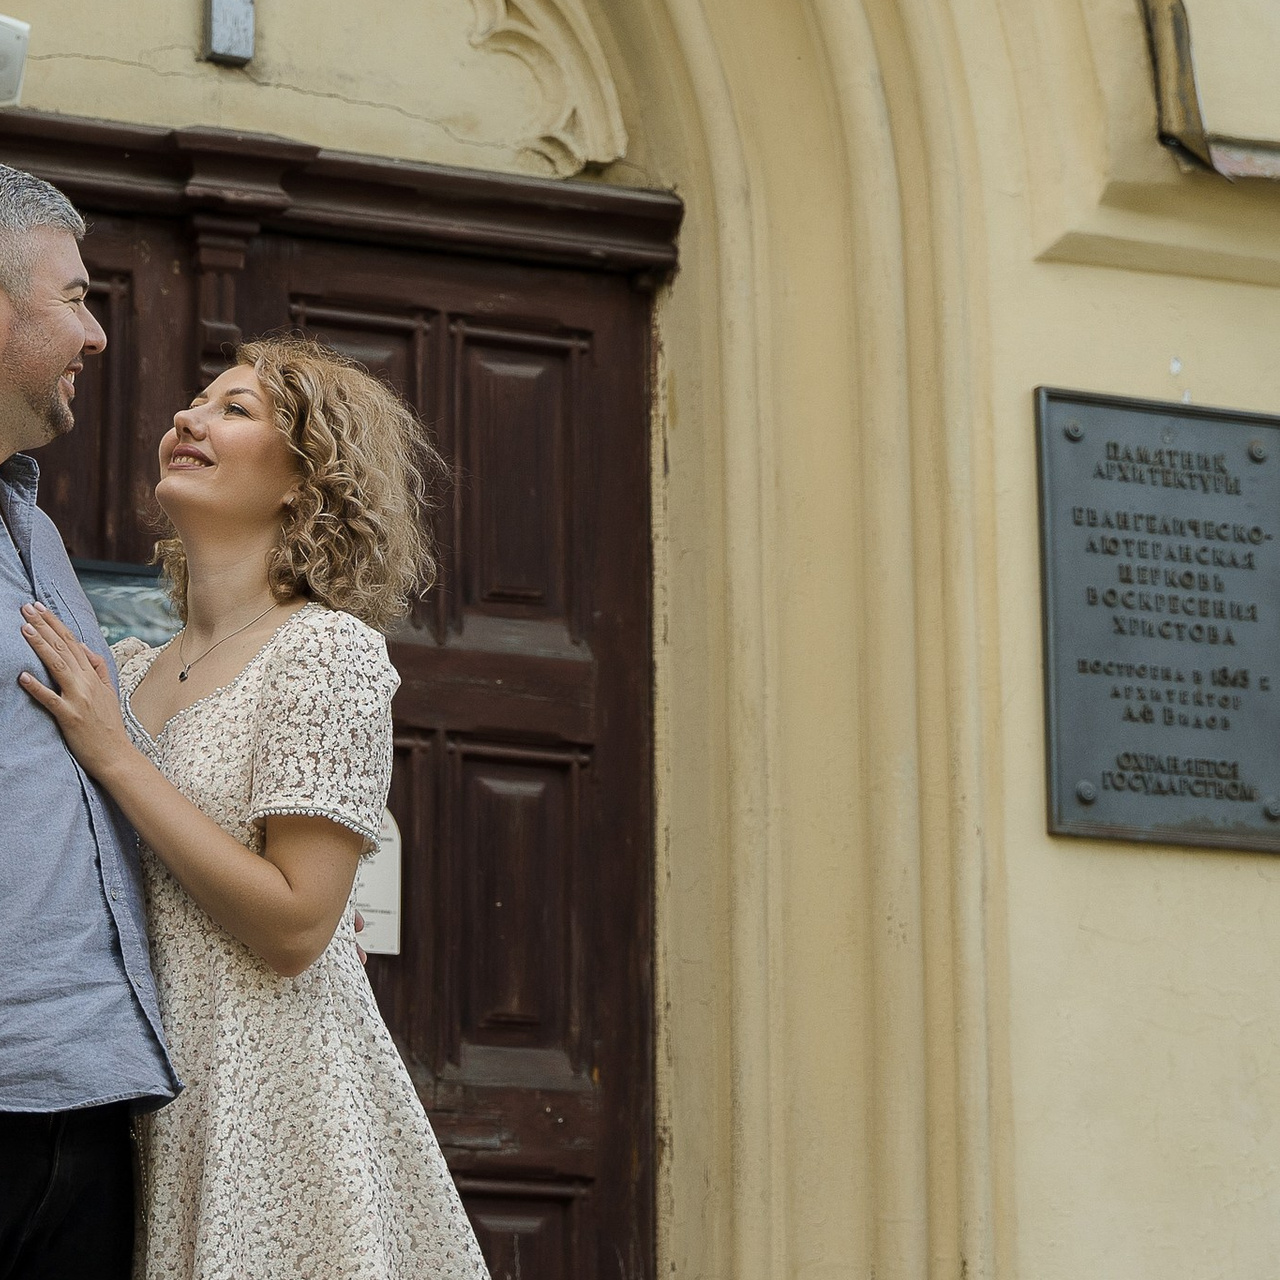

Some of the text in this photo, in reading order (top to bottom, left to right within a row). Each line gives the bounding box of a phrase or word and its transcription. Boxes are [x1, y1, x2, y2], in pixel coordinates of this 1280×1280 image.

[1105, 440, 1228, 474] ПАМЯТНИК
[1093, 461, 1242, 496] АРХИТЕКТУРЫ
[1072, 506, 1273, 545] ЕВАНГЕЛИЧЕСКО-
[1085, 535, 1256, 570] ЛЮТЕРАНСКАЯ
[1118, 563, 1225, 593] ЦЕРКОВЬ
[1086, 585, 1258, 622] ВОСКРЕСЕНИЯ
[1113, 615, 1236, 646] ХРИСТОВА
[1117, 752, 1240, 780] ОХРАНЯЕТСЯ
[1102, 771, 1256, 802] ГОСУДАРСТВОМ
